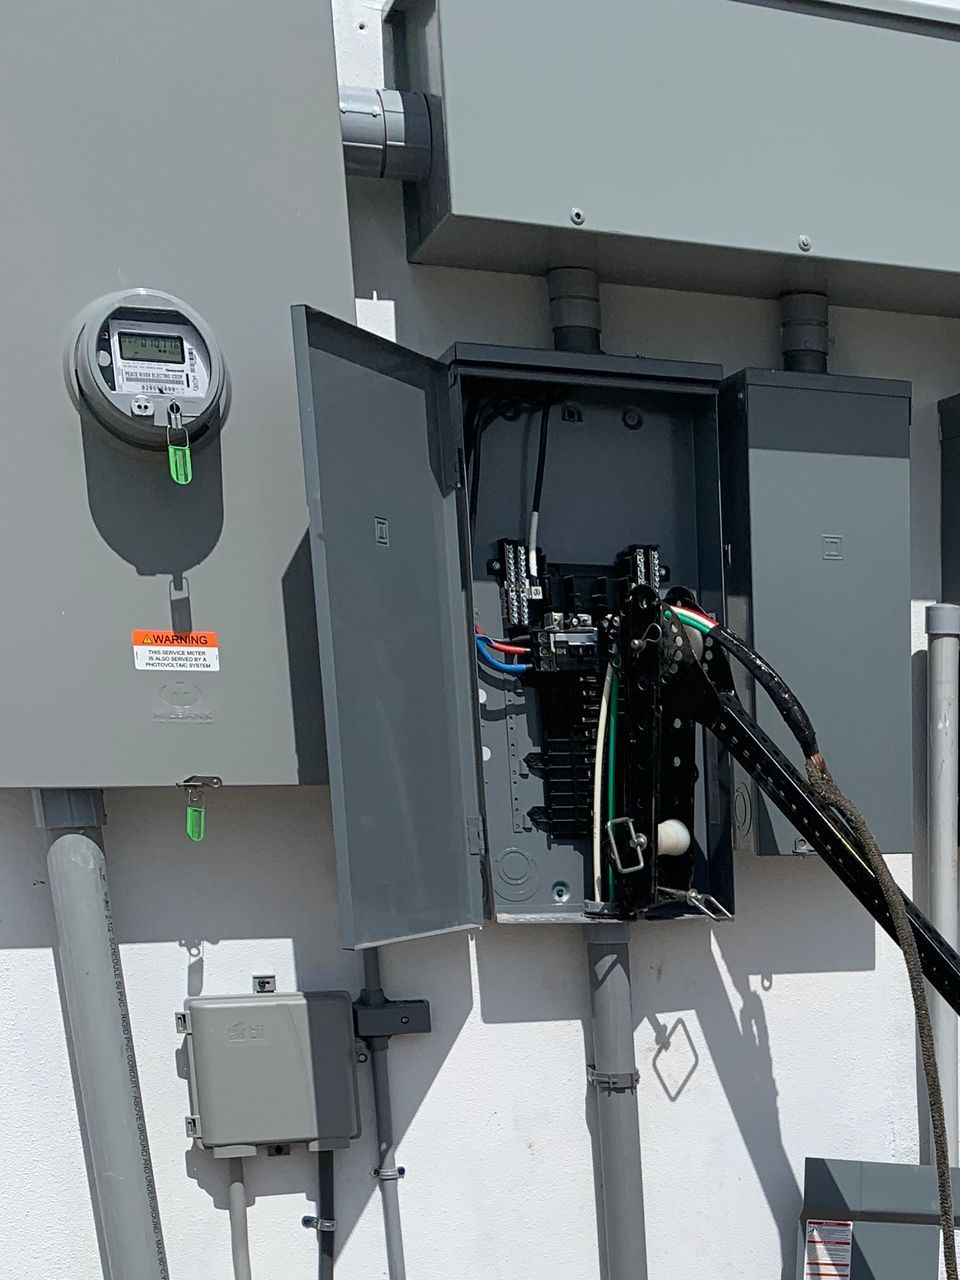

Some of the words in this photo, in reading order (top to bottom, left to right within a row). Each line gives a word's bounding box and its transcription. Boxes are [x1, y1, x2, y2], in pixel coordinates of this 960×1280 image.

[153, 634, 208, 645] WARNING
[119, 1012, 129, 1035] RIGID
[123, 1035, 132, 1054] PVC
[126, 1054, 138, 1089] CONDUIT
[132, 1094, 143, 1123] ABOVE
[136, 1123, 148, 1156] GROUND
[141, 1157, 150, 1175] AND
[144, 1175, 159, 1234] UNDERGROUND
